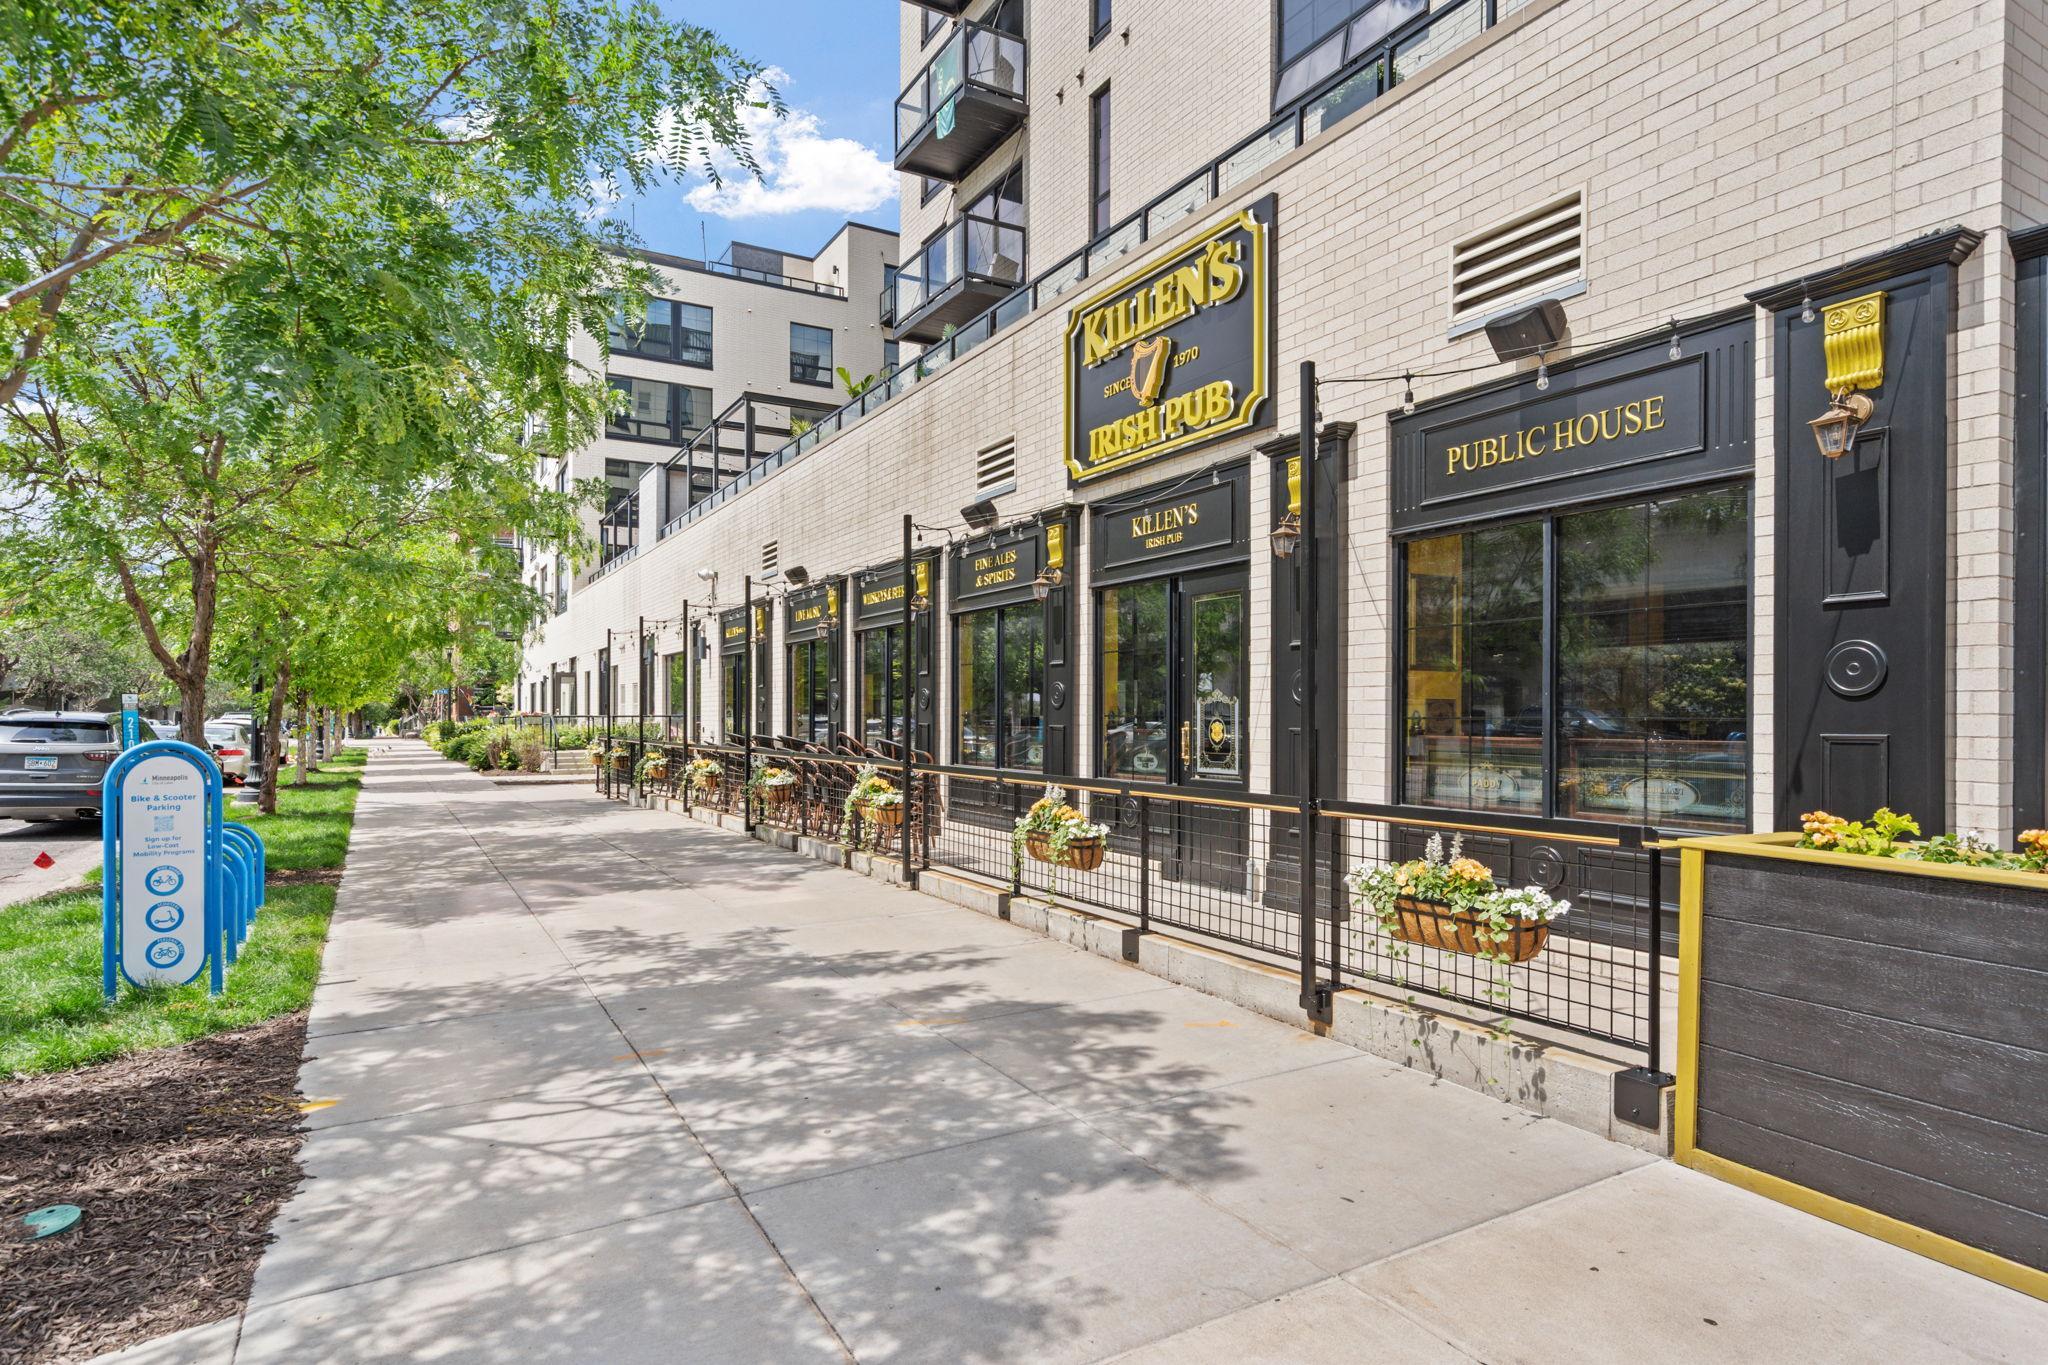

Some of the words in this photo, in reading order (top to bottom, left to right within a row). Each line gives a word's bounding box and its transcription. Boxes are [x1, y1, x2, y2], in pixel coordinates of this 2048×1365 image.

[1083, 240, 1242, 367] KILLEN'S
[1104, 376, 1131, 398] SINCE
[1173, 346, 1199, 368] 1970
[1089, 405, 1160, 462] IRISH
[1164, 381, 1233, 436] PUB
[1445, 425, 1547, 475] PUBLIC
[1553, 395, 1666, 451] HOUSE
[1132, 503, 1198, 538] KILLEN'S
[1146, 535, 1166, 549] IRISH
[1166, 531, 1183, 544] PUB
[975, 556, 994, 571] FINE
[994, 549, 1017, 567] ALES
[975, 575, 983, 587] &
[983, 567, 1016, 586] SPIRITS
[152, 774, 188, 782] Minneapolis
[131, 794, 151, 802] Bike
[163, 793, 196, 801] Scooter
[147, 803, 181, 811] Parking
[133, 850, 162, 858] Mobility
[163, 848, 195, 856] Programs
